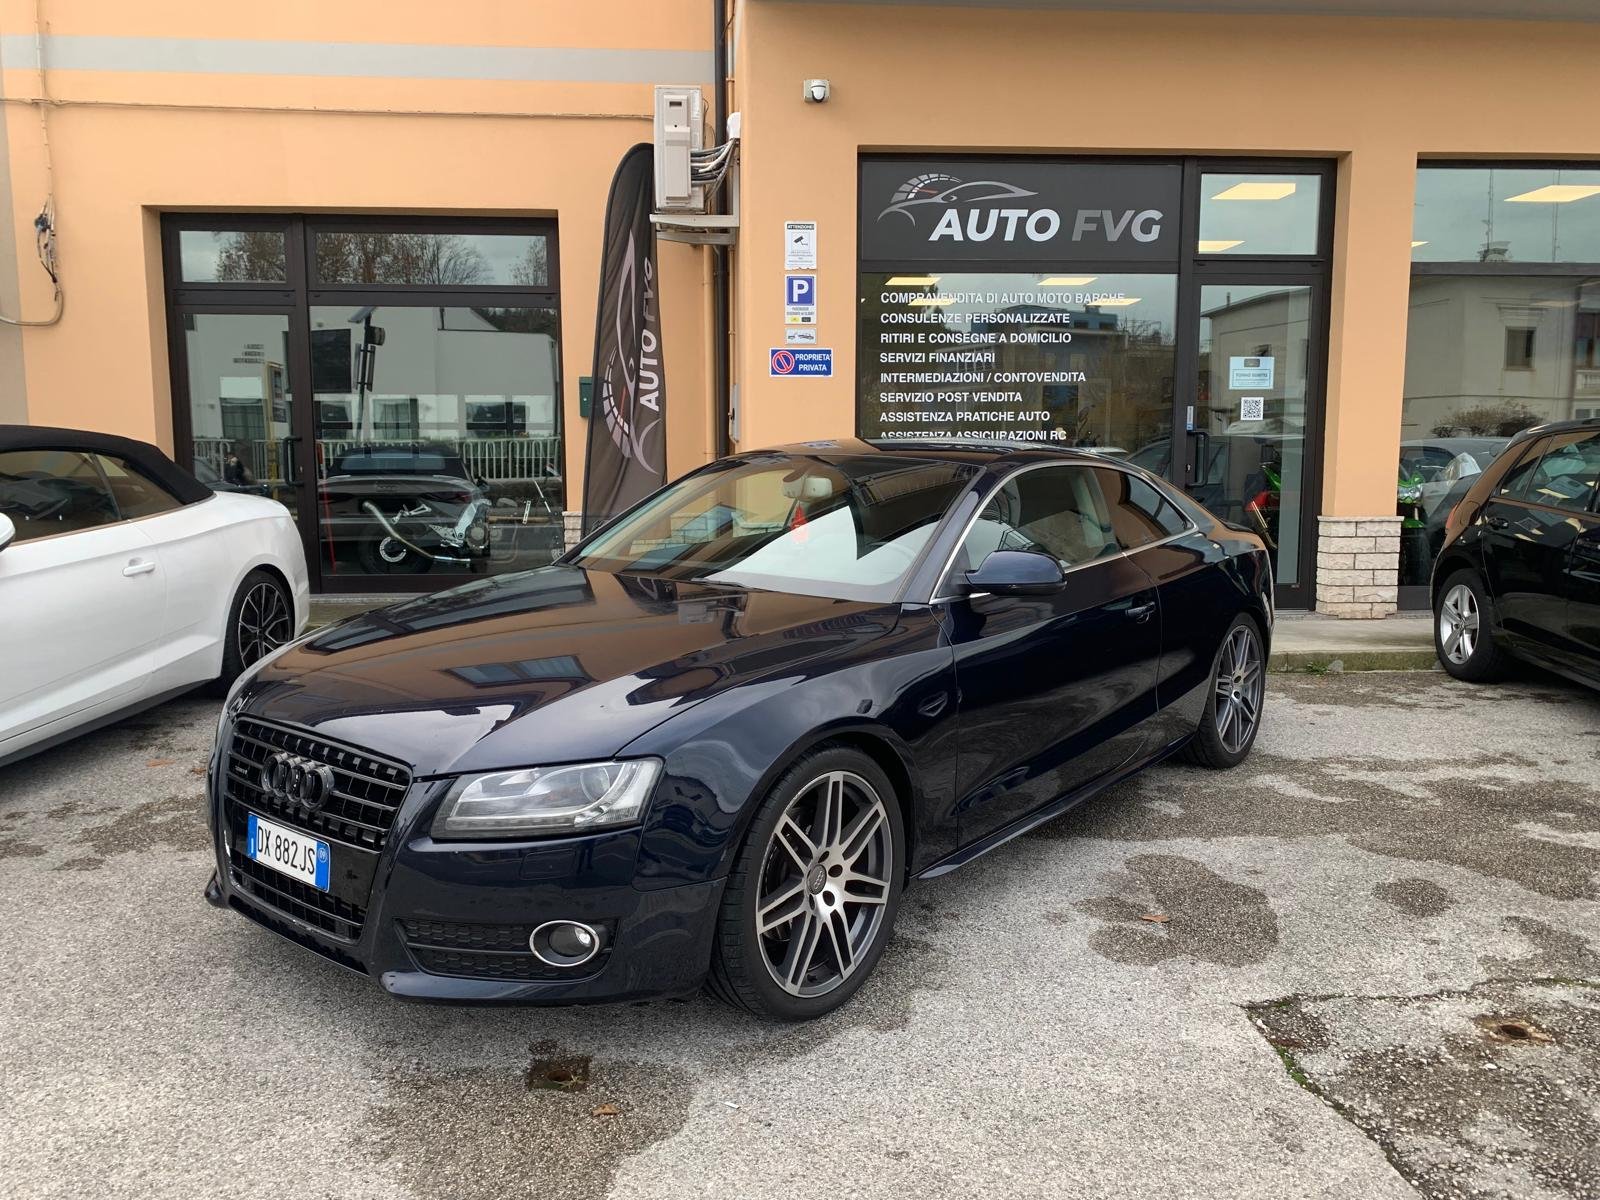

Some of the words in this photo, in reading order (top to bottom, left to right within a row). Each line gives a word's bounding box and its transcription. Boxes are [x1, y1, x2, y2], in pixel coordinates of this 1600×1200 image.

[928, 209, 1060, 242] AUTO
[1072, 209, 1164, 242] FVG
[792, 279, 809, 302] P
[881, 292, 982, 304] COMPRAVENDITA
[986, 293, 998, 303] DI
[1002, 293, 1033, 304] AUTO
[1038, 293, 1072, 304] MOTO
[1075, 292, 1124, 304] BARCHE
[881, 313, 961, 324] CONSULENZE
[965, 313, 1070, 324] PERSONALIZZATE
[880, 333, 914, 343] RITIRI
[918, 333, 926, 343] E
[929, 333, 996, 344] CONSEGNE
[998, 333, 1007, 343] A
[1010, 332, 1072, 343] DOMICILIO
[880, 352, 925, 363] SERVIZI
[929, 352, 995, 363] FINANZIARI
[639, 329, 659, 411] AUTO
[798, 364, 827, 372] PRIVATA
[880, 372, 984, 383] INTERMEDIAZIONI
[986, 372, 992, 383] /
[995, 372, 1086, 383] CONTOVENDITA
[880, 392, 934, 403] SERVIZIO
[938, 392, 970, 403] POST
[972, 392, 1022, 402] VENDITA
[880, 412, 953, 422] ASSISTENZA
[956, 411, 1014, 422] PRATICHE
[1018, 411, 1050, 422] AUTO
[257, 825, 271, 857] DX
